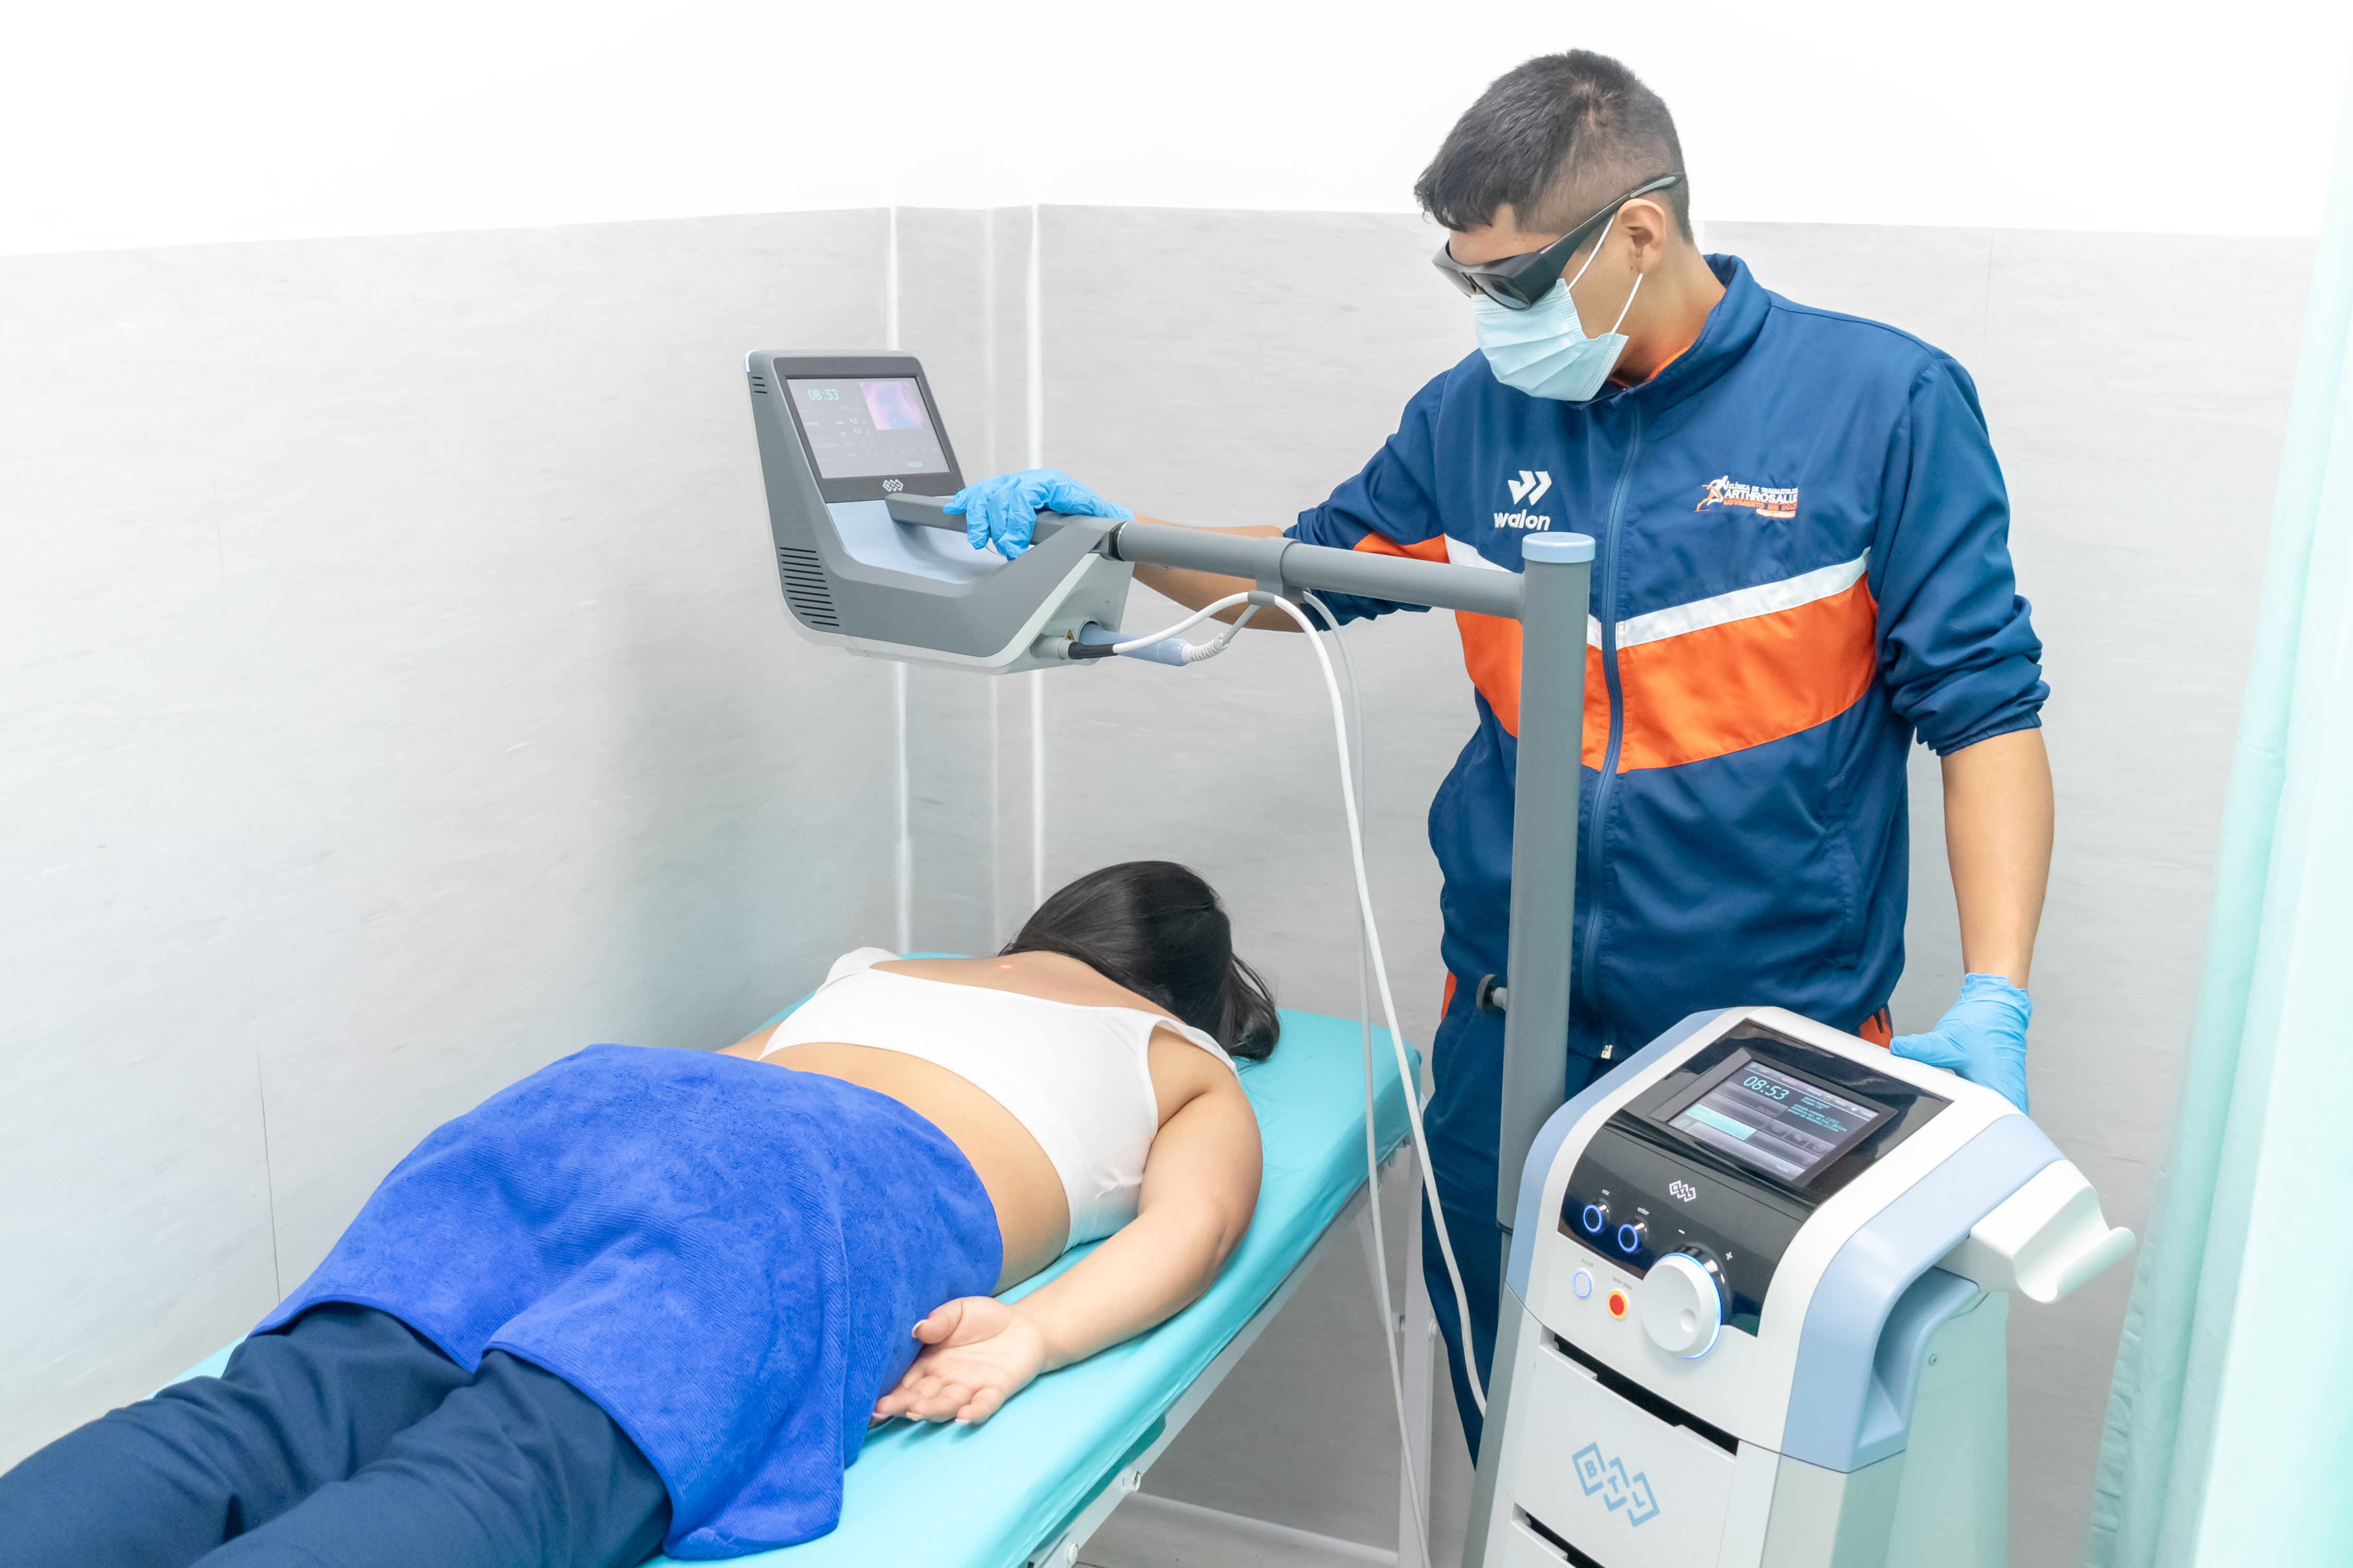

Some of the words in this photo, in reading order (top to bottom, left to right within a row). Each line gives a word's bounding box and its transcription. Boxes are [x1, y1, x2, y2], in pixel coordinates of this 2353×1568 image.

[807, 389, 839, 400] 08:53
[1723, 498, 1765, 508] MOVIMIENTO
[1494, 509, 1551, 531] walon
[1743, 1076, 1790, 1100] 08:53
